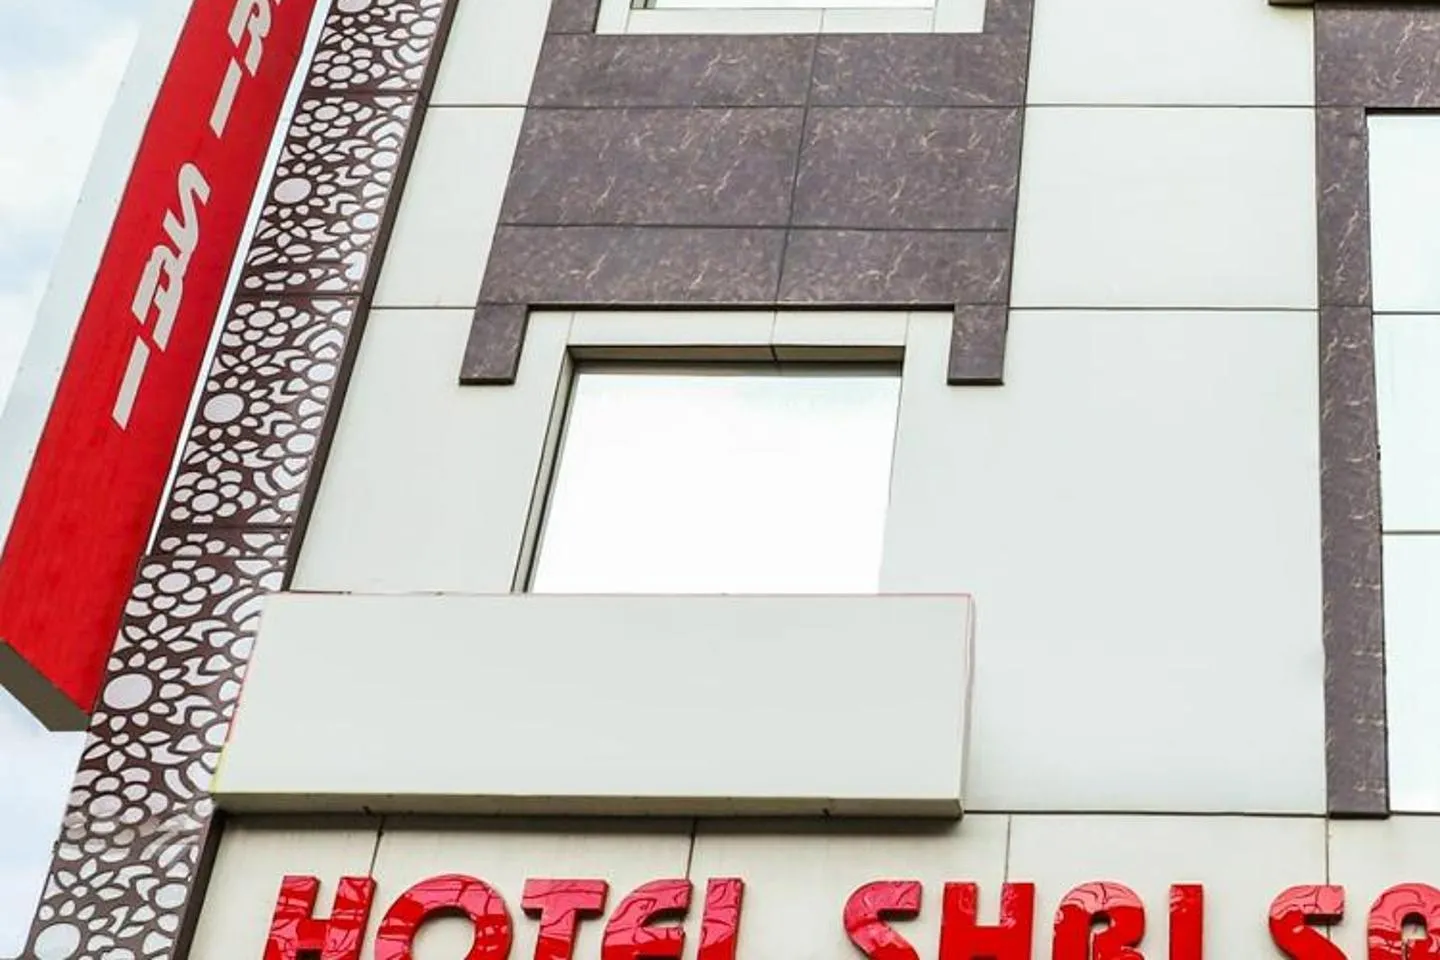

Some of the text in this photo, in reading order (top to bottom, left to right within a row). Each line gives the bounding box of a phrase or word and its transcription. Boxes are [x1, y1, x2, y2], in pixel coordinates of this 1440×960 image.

[112, 161, 211, 430] SAI
[261, 873, 745, 960] HOTEL
[844, 880, 1204, 960] SHRI
